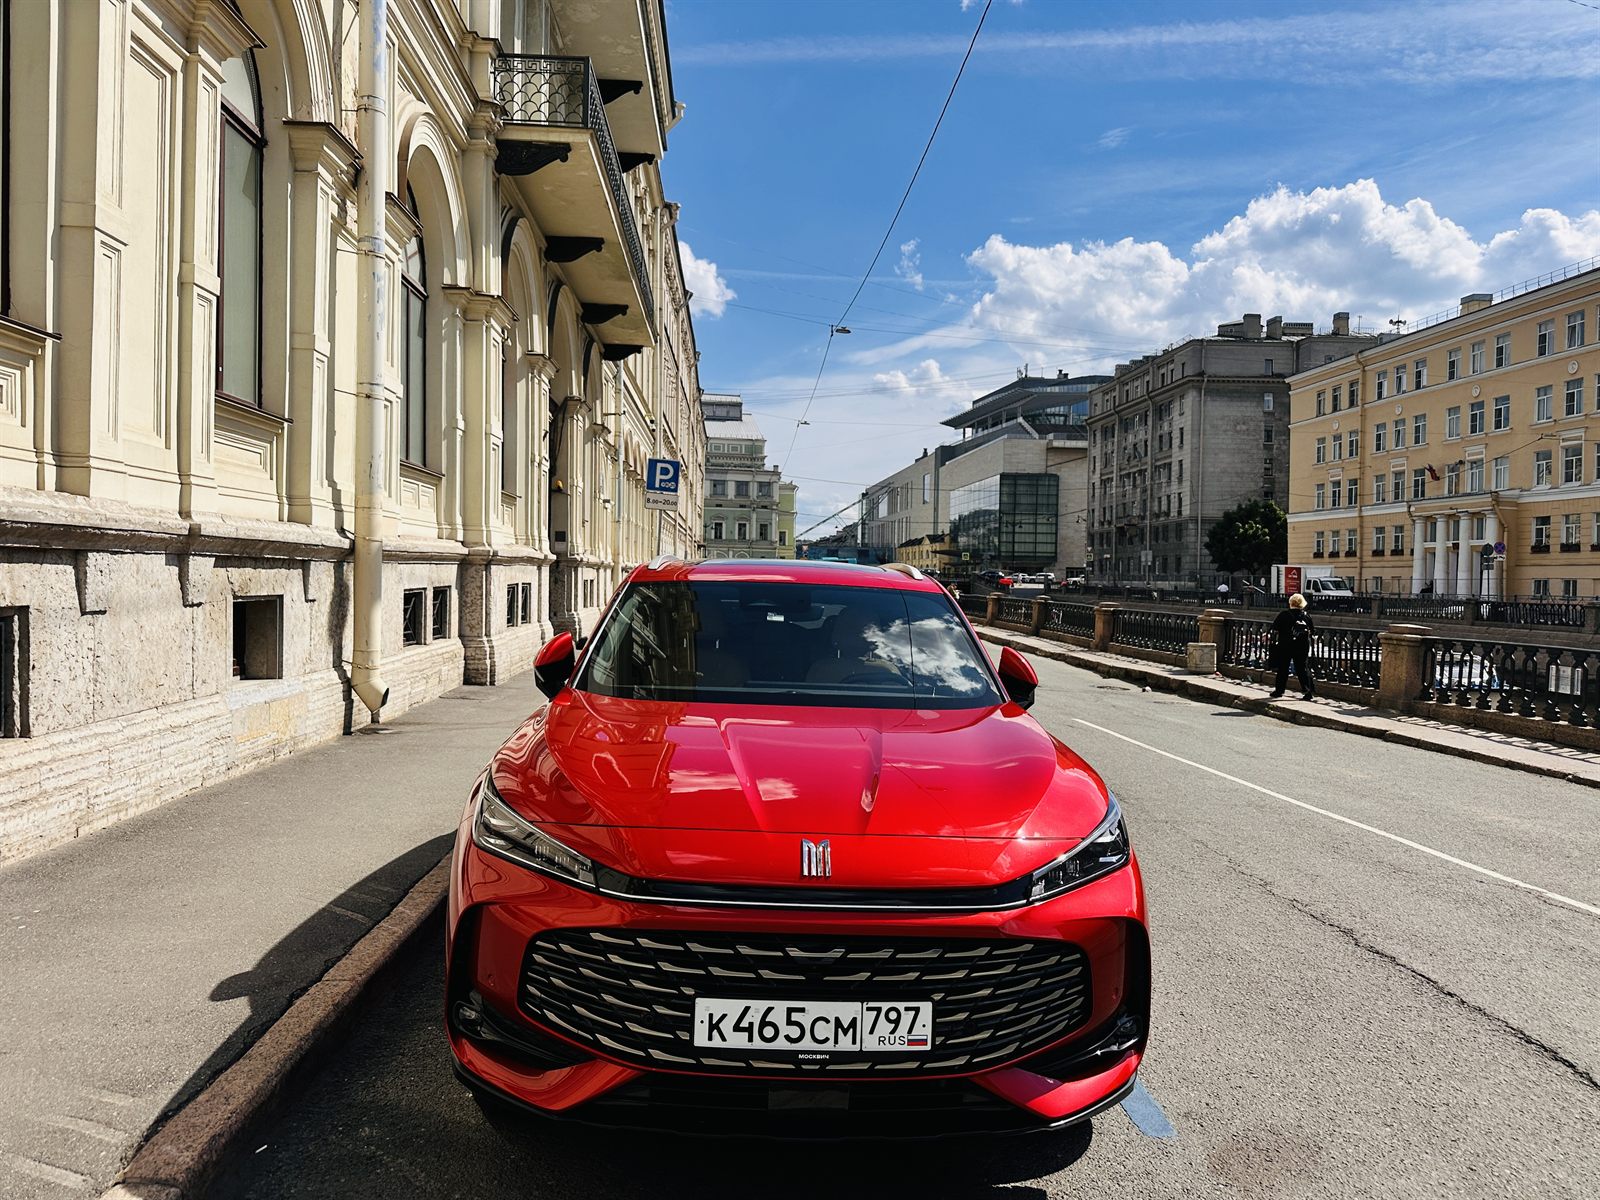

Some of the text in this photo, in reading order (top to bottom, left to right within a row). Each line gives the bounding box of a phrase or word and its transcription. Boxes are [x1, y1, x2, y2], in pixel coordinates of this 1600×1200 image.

[655, 462, 674, 488] P
[866, 1006, 921, 1035] 797
[878, 1035, 906, 1046] RUS
